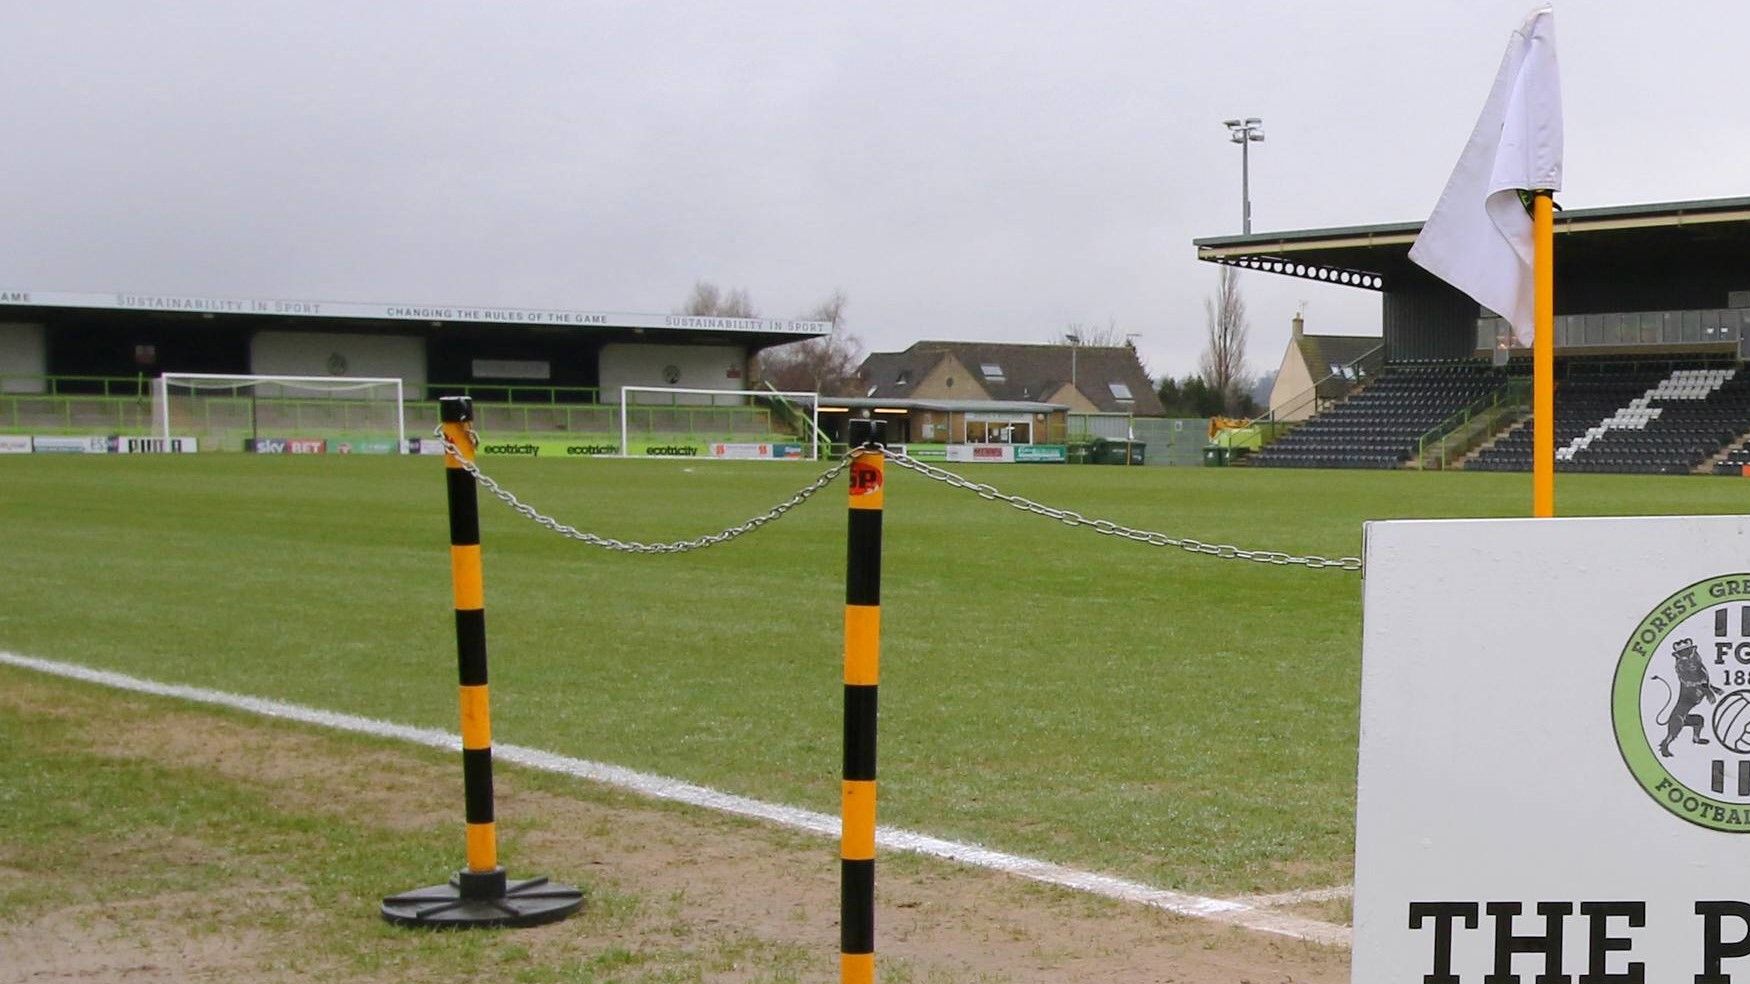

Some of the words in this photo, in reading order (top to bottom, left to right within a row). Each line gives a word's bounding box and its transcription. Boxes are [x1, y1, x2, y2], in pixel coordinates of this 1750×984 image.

[116, 293, 242, 310] SUSTAINABILITY
[251, 300, 267, 311] IN
[275, 301, 320, 314] SPORT
[387, 306, 451, 318] CHANGING
[457, 309, 480, 319] THE
[484, 310, 523, 321] RULES
[527, 312, 543, 322] OF
[549, 312, 571, 323] THE
[575, 314, 608, 324] GAME
[665, 315, 763, 331] SUSTAINABILITY
[769, 322, 782, 331] IN
[788, 322, 824, 332] SPORT
[256, 439, 286, 454] sky
[291, 442, 322, 454] BET
[484, 443, 540, 457] ecotricity
[567, 443, 620, 456] ecotricity
[646, 445, 698, 457] ecotricity
[1632, 592, 1699, 657] FOREST
